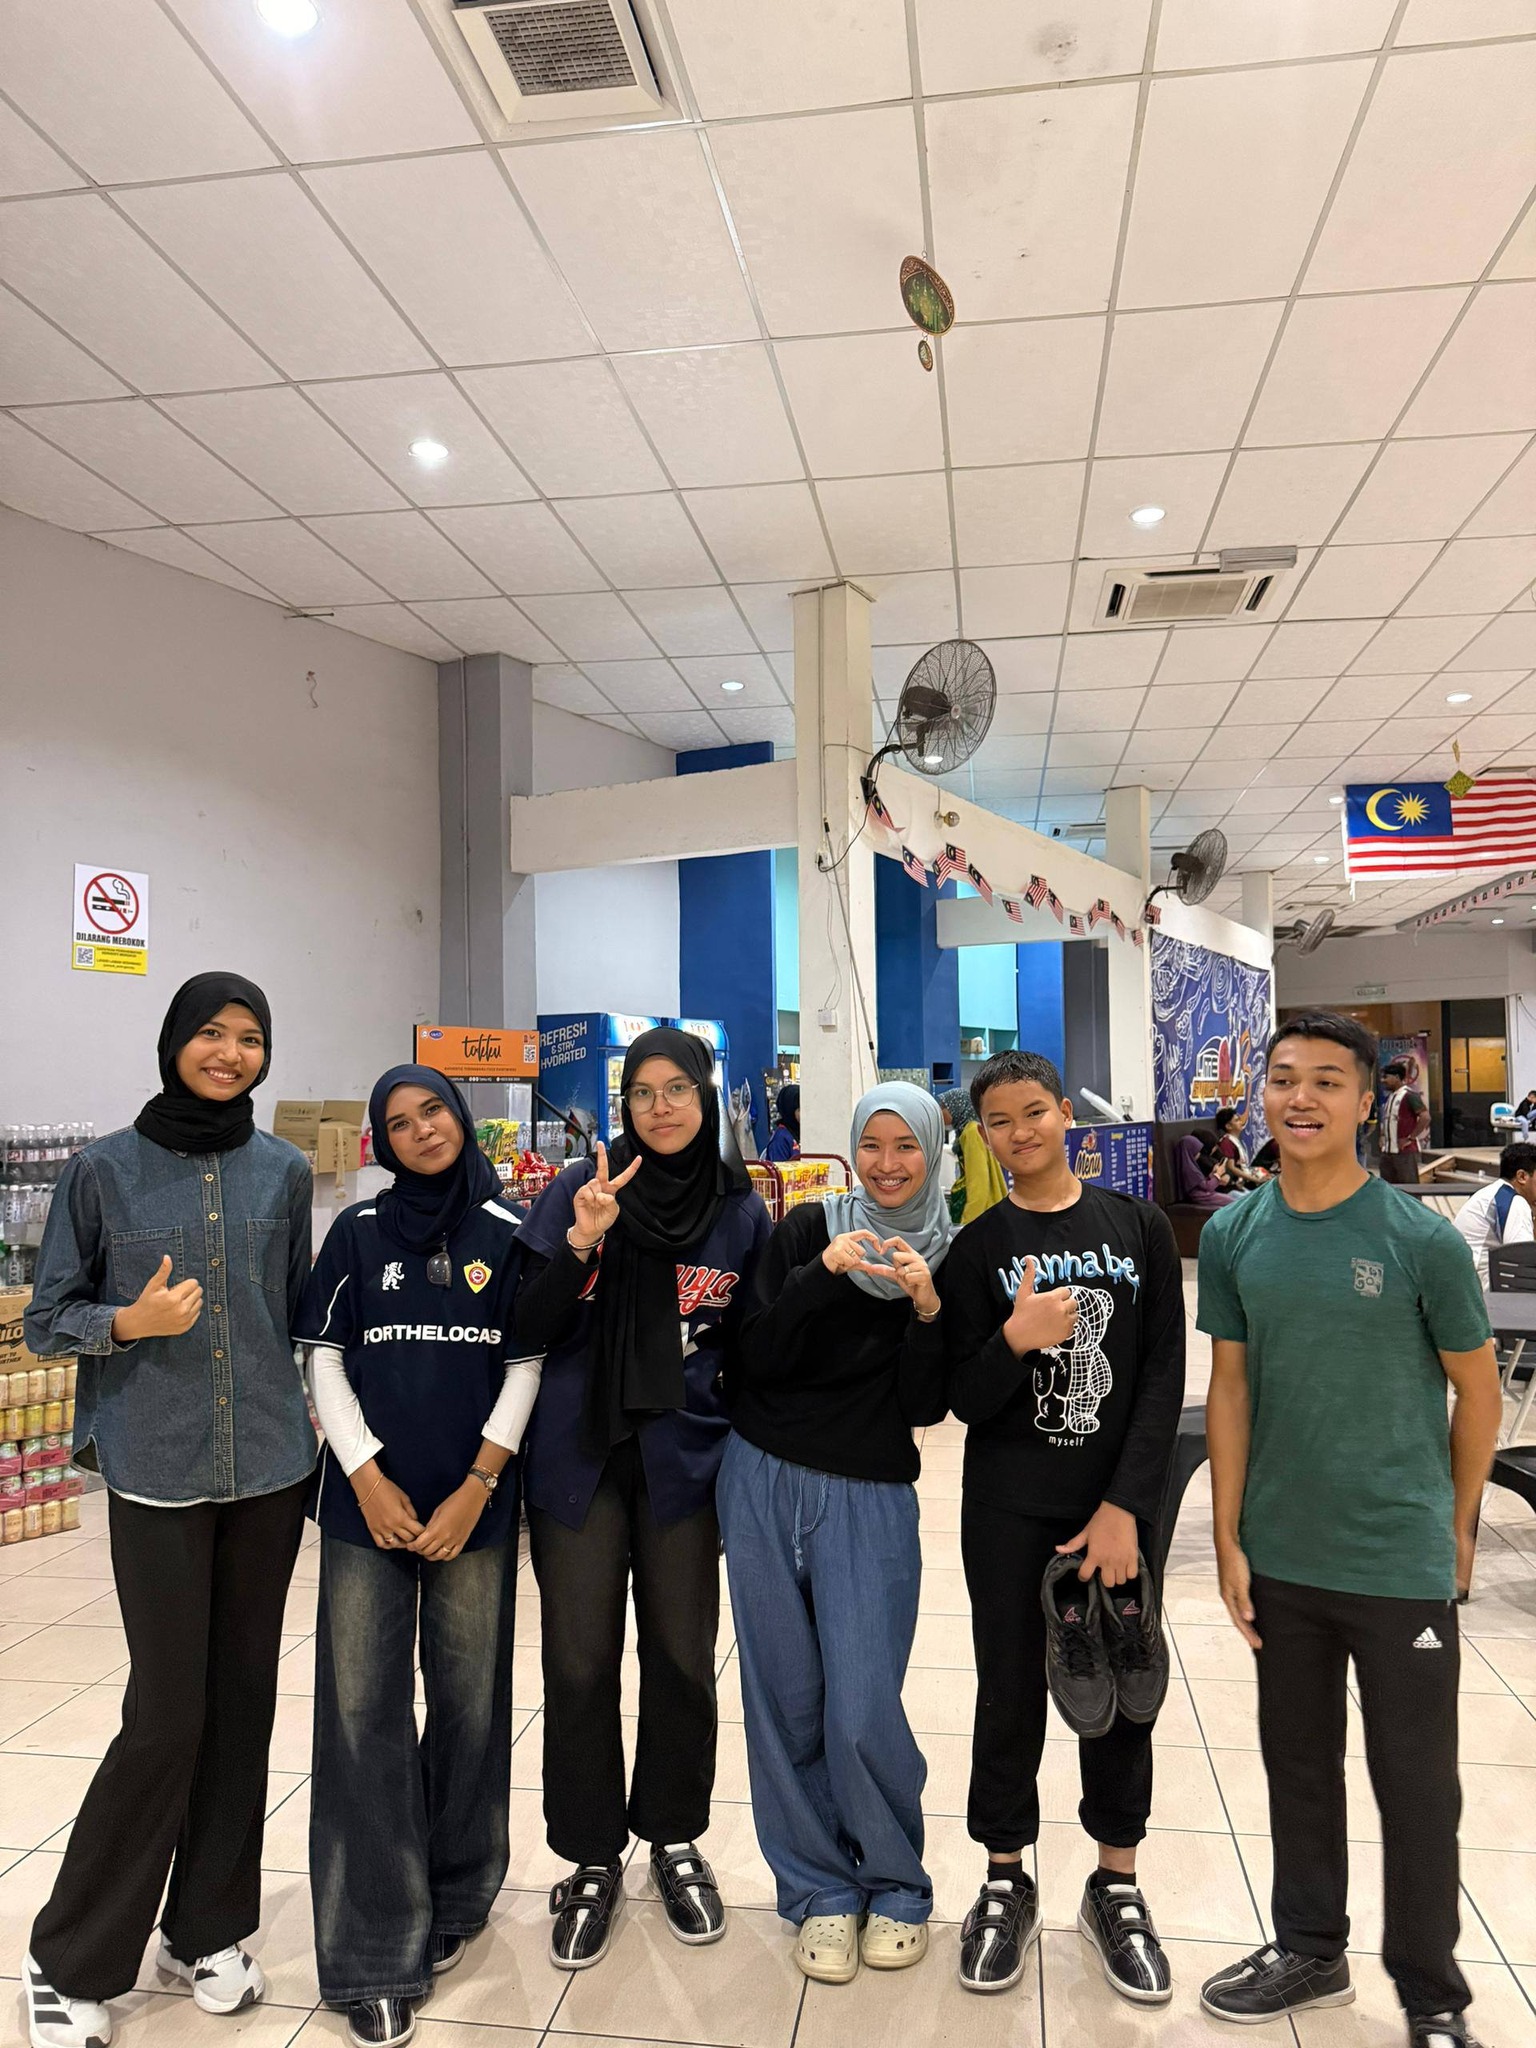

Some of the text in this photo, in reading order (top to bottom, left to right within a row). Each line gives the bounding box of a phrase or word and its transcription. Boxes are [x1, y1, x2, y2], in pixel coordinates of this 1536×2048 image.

[76, 932, 146, 947] DILARANG MEROKOK
[540, 1020, 588, 1048] REFRESH
[551, 1039, 576, 1055] & STAY
[541, 1046, 587, 1070] HYDRATED
[1075, 1149, 1103, 1180] Menu
[0, 1326, 24, 1342] ILO
[1048, 1435, 1085, 1447] myself
